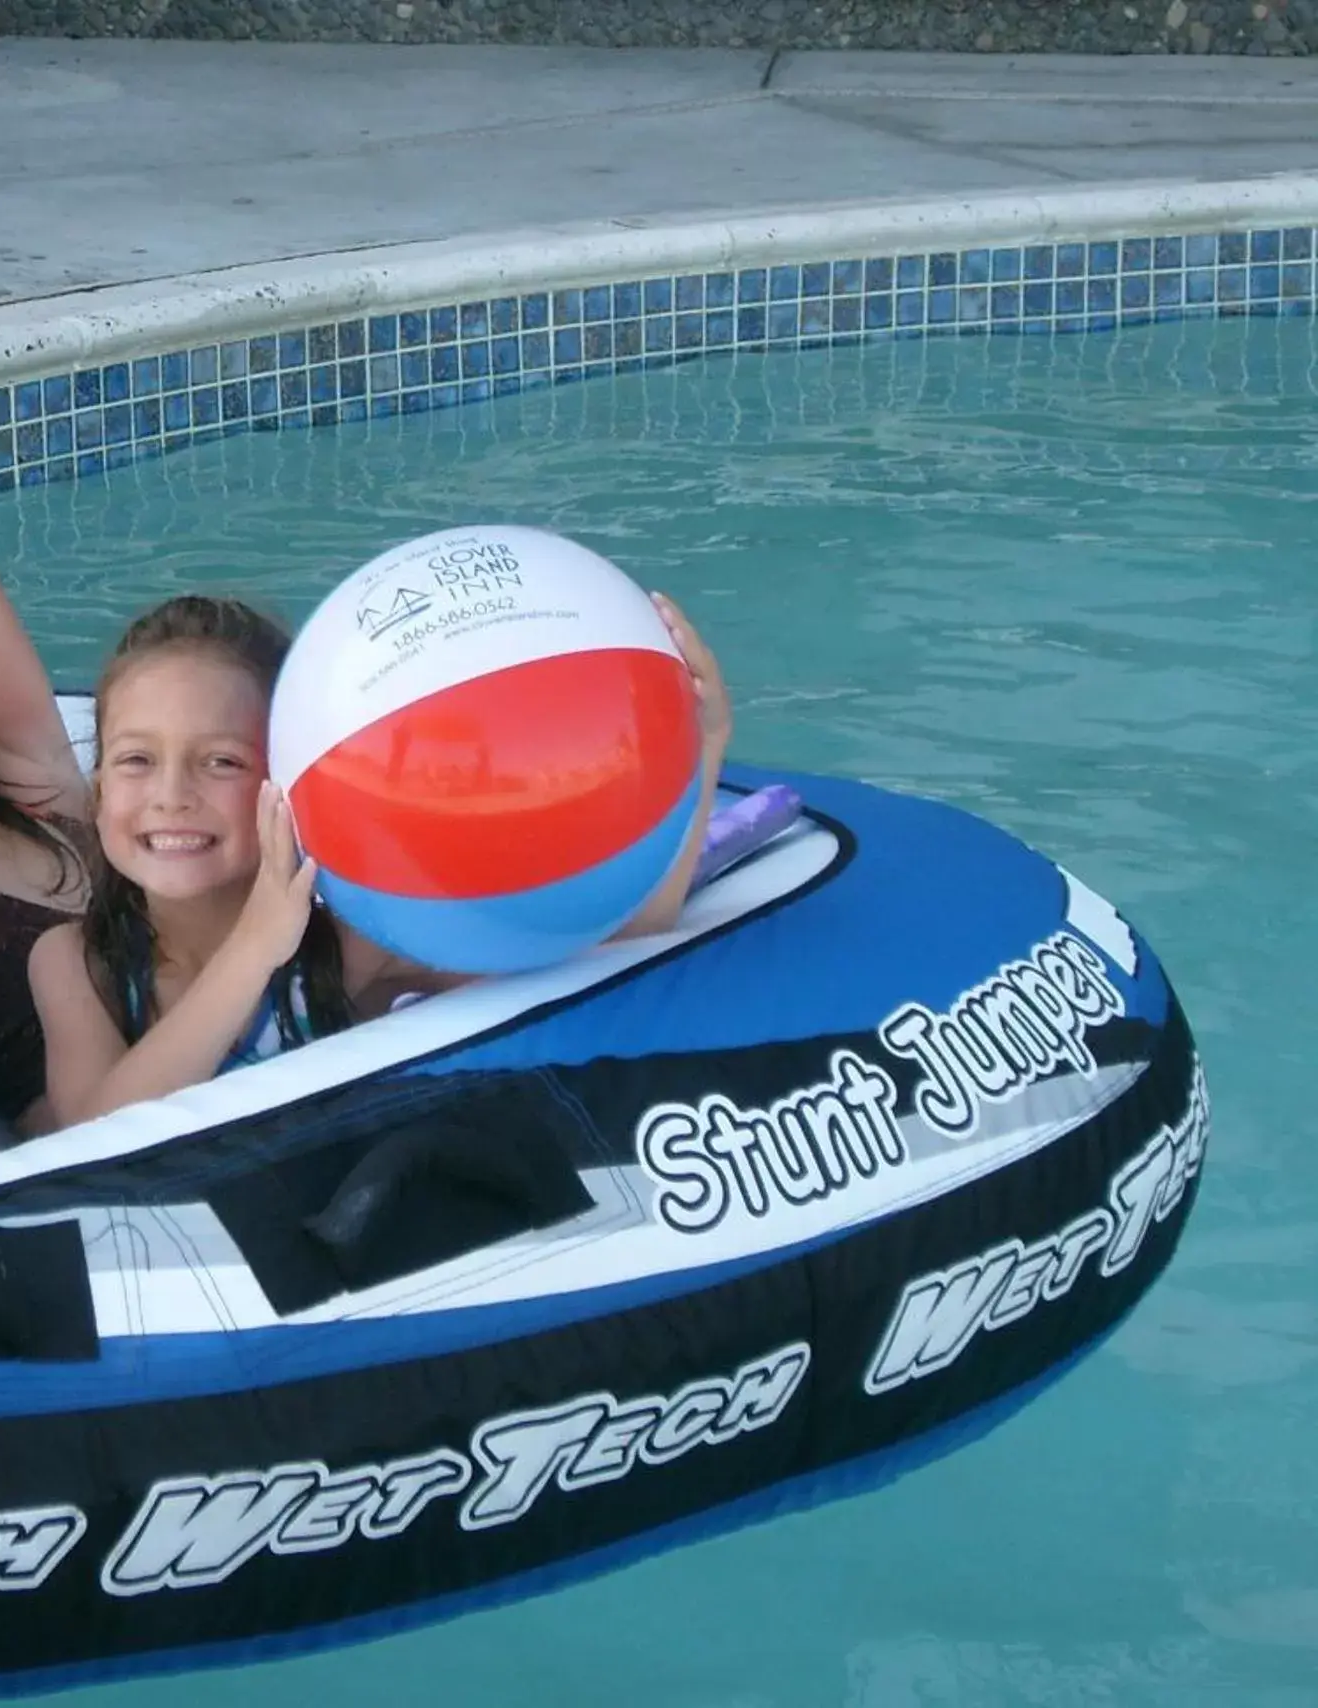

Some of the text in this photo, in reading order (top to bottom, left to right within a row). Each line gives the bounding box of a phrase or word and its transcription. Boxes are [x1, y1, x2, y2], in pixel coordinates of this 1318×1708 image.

[428, 543, 515, 570] CLOVER
[434, 557, 520, 588] ISLAND
[448, 573, 524, 602] INN
[635, 930, 1125, 1234] Stunt Jumper
